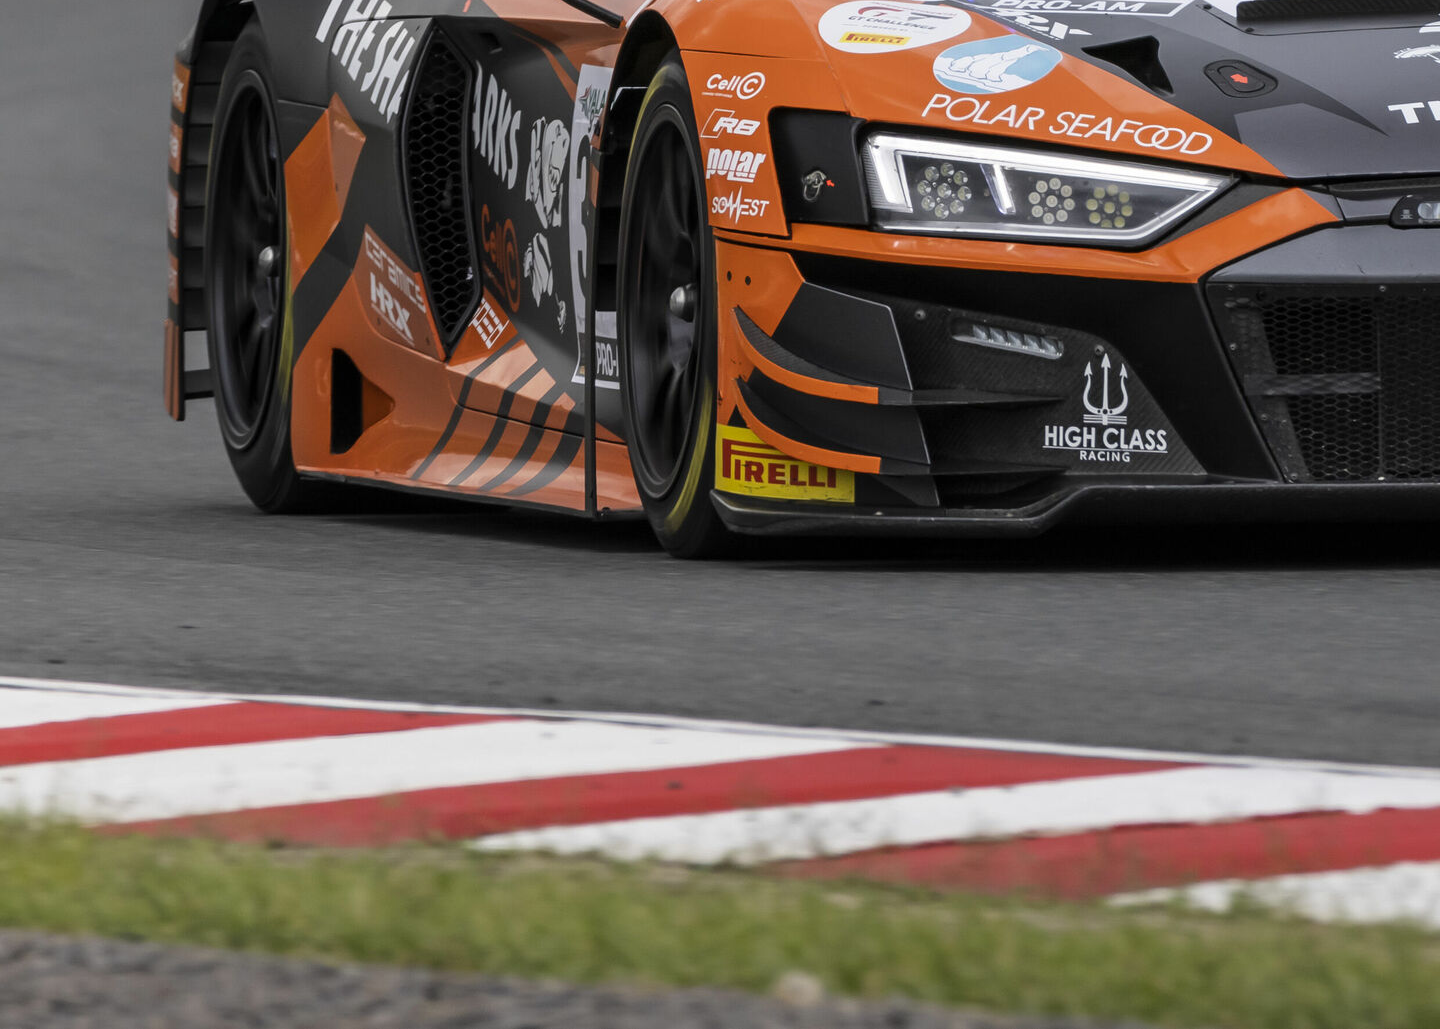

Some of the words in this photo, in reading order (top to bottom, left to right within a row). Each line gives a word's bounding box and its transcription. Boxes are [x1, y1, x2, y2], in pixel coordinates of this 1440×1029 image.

[866, 17, 937, 31] CHALLENGE
[706, 73, 741, 91] Cell
[713, 116, 761, 136] R8
[922, 93, 1045, 131] POLAR
[1050, 111, 1213, 155] SEAFOOD
[370, 271, 414, 342] HRX
[1045, 425, 1096, 448] HIGH
[1102, 427, 1168, 451] CLASS
[722, 438, 837, 488] PIRELLI
[1079, 451, 1131, 463] RACING
